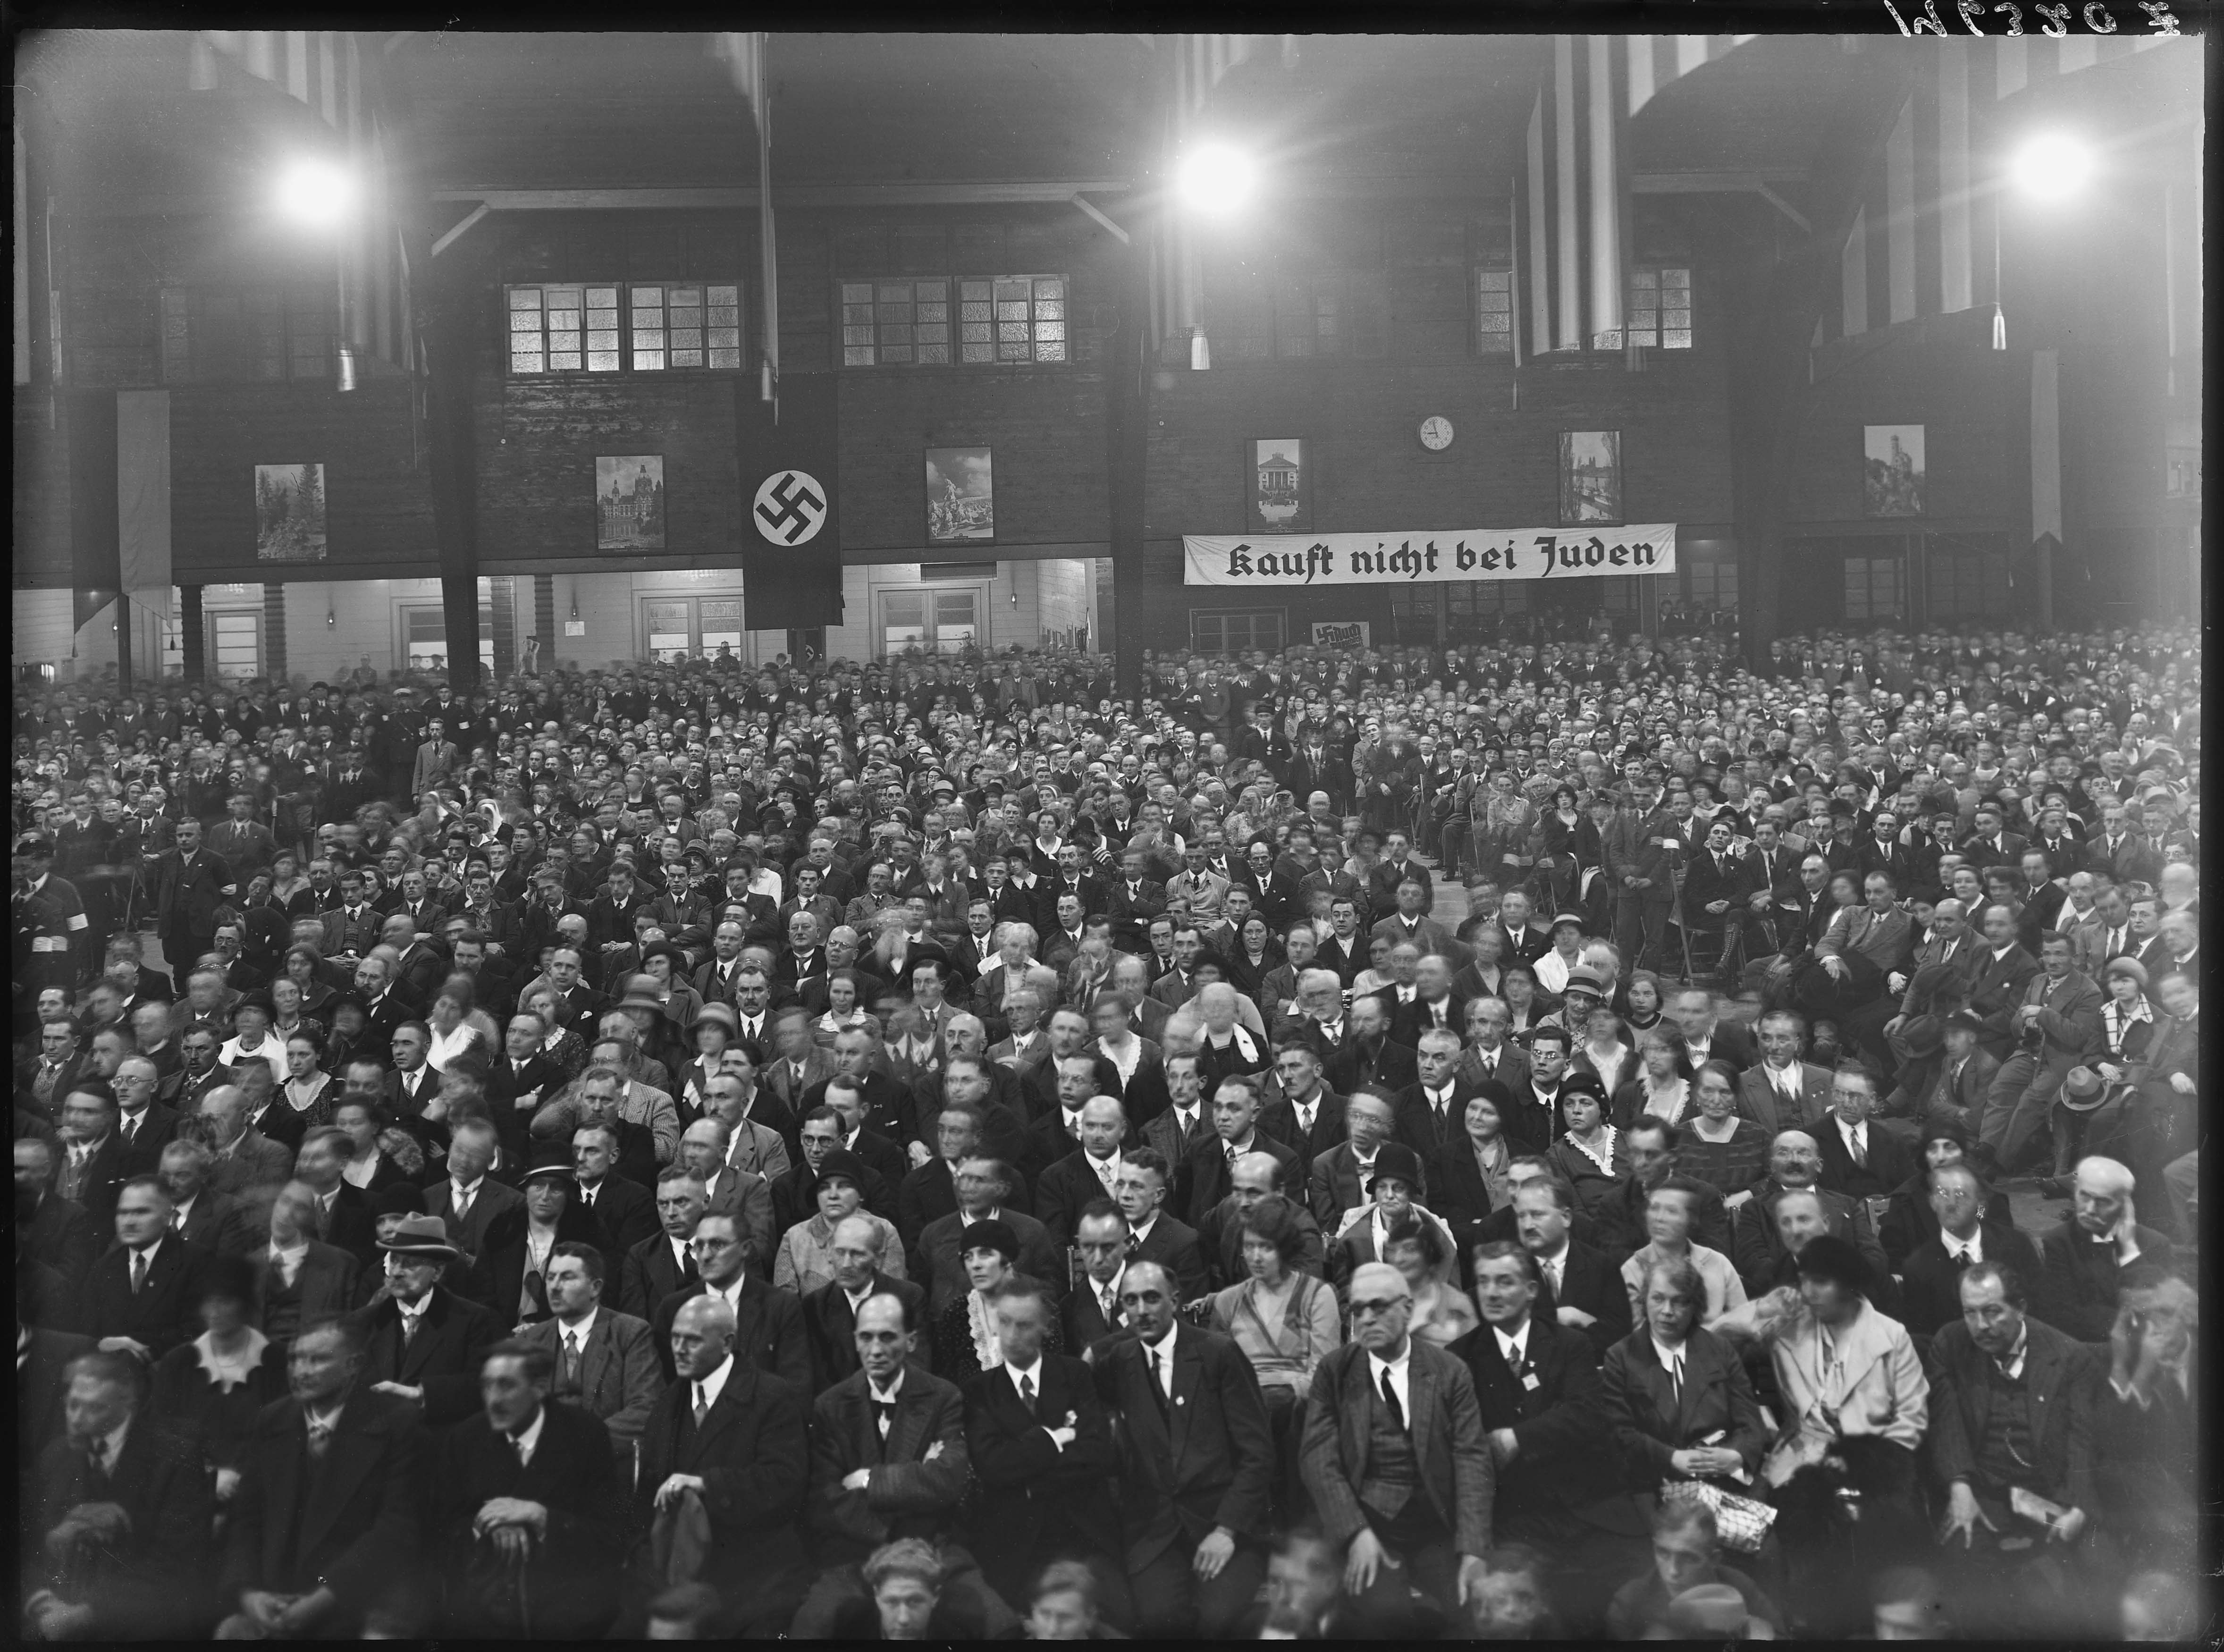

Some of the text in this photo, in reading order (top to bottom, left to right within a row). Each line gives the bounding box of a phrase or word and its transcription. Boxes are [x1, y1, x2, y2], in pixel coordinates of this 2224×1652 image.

[1226, 536, 1656, 584] Kauft nicht bei Juden
